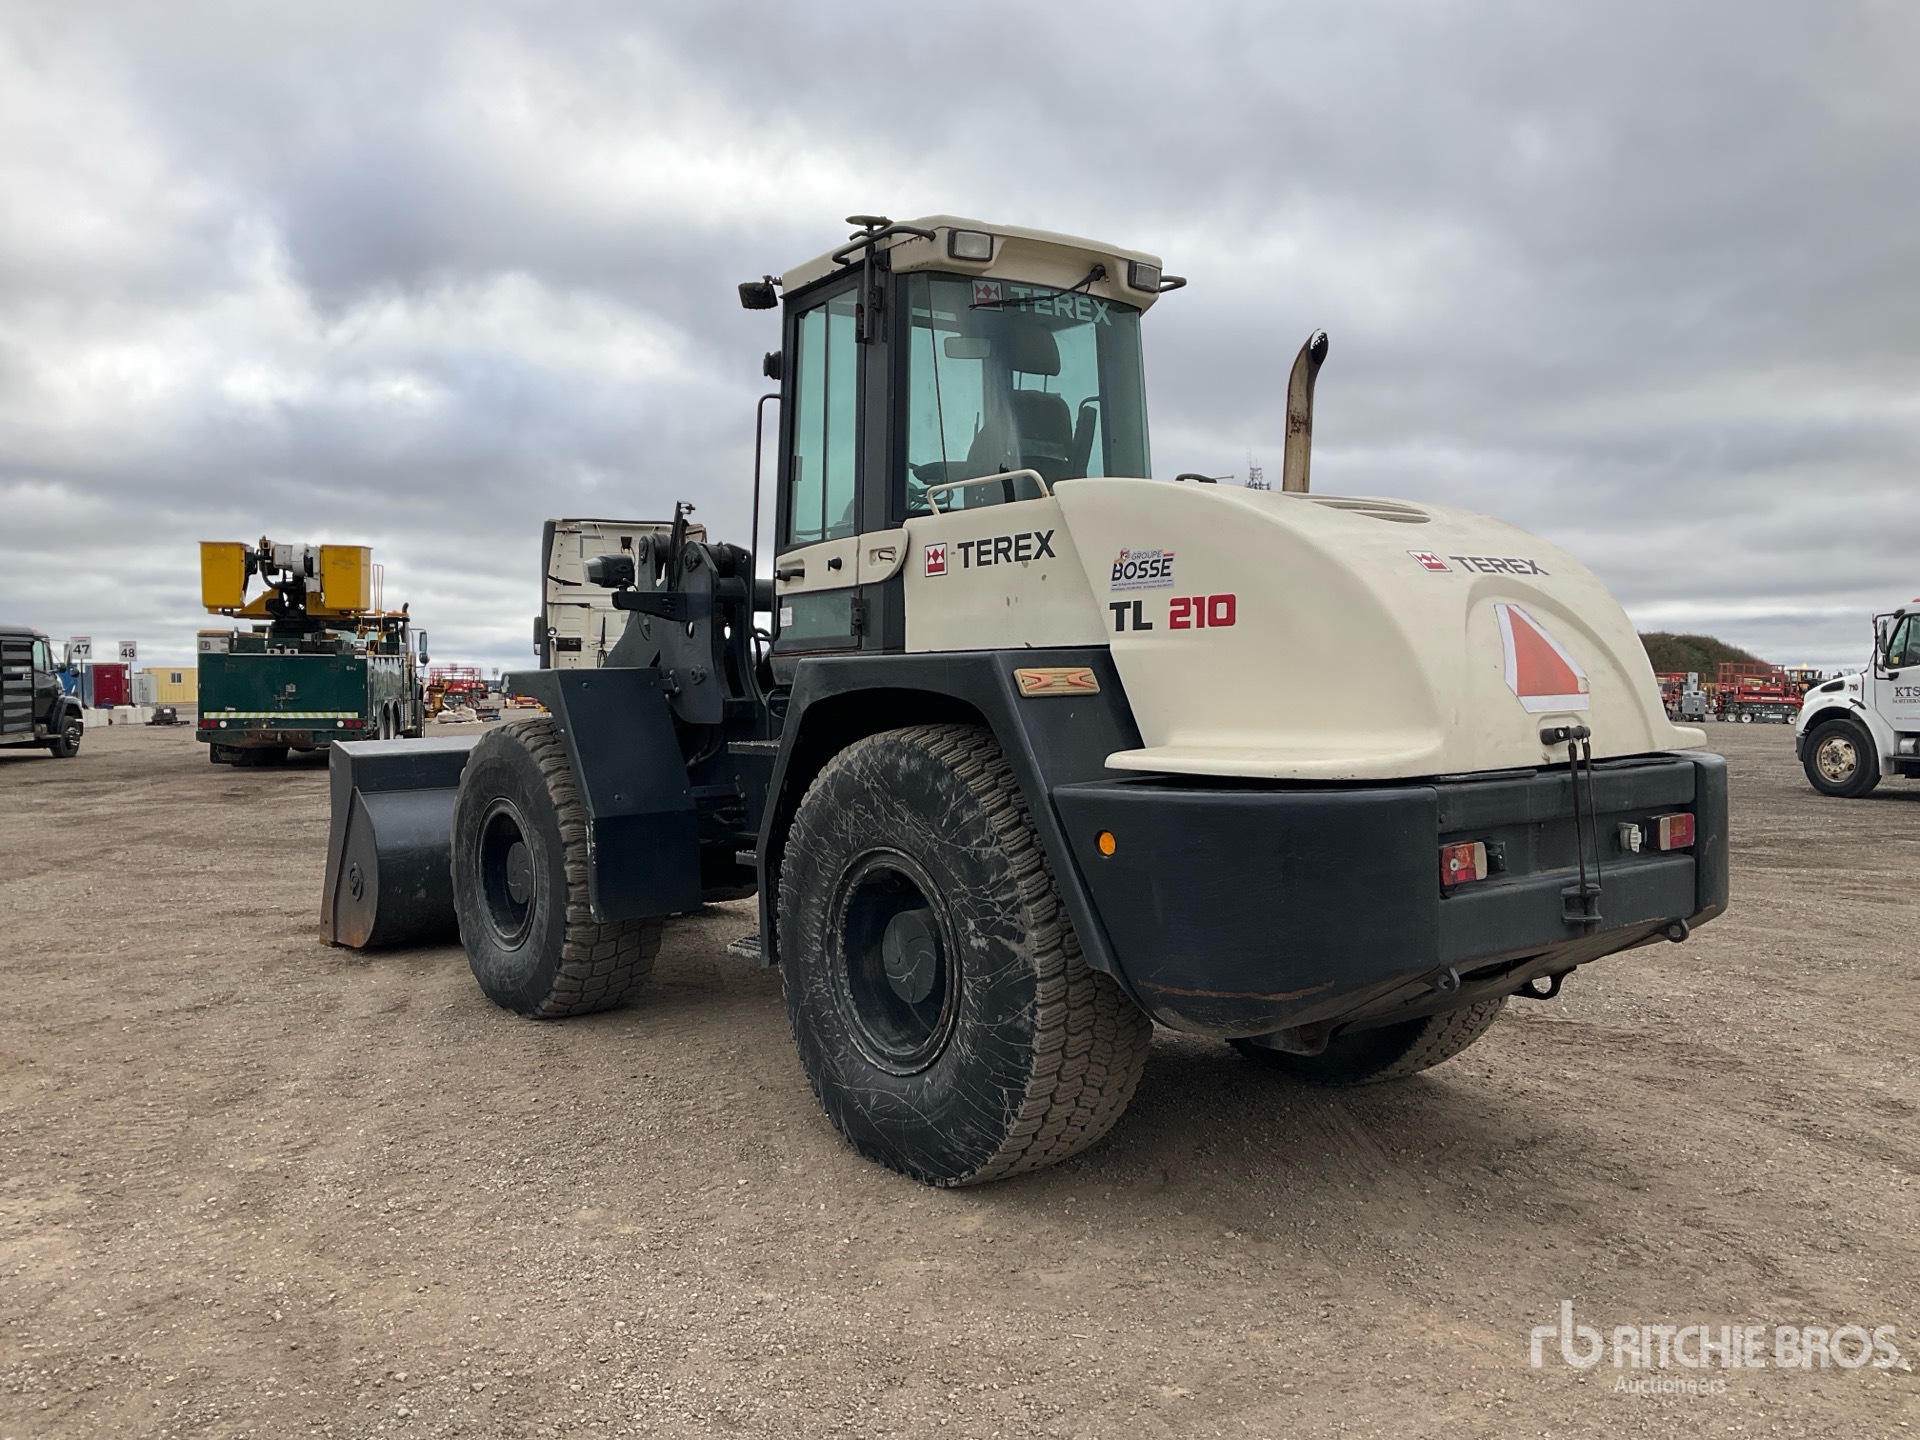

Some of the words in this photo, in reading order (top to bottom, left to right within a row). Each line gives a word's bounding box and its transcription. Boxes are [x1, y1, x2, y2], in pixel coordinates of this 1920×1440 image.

[1010, 286, 1112, 326] TEREX
[957, 529, 1056, 568] TEREX
[1131, 550, 1162, 560] GROUPE
[1111, 558, 1174, 581] BOSSE
[1448, 555, 1550, 576] TEREX
[1109, 600, 1153, 632] TL
[1169, 594, 1236, 630] 210
[73, 645, 90, 654] 47
[121, 649, 135, 657] 48
[1895, 686, 1920, 696] KTS
